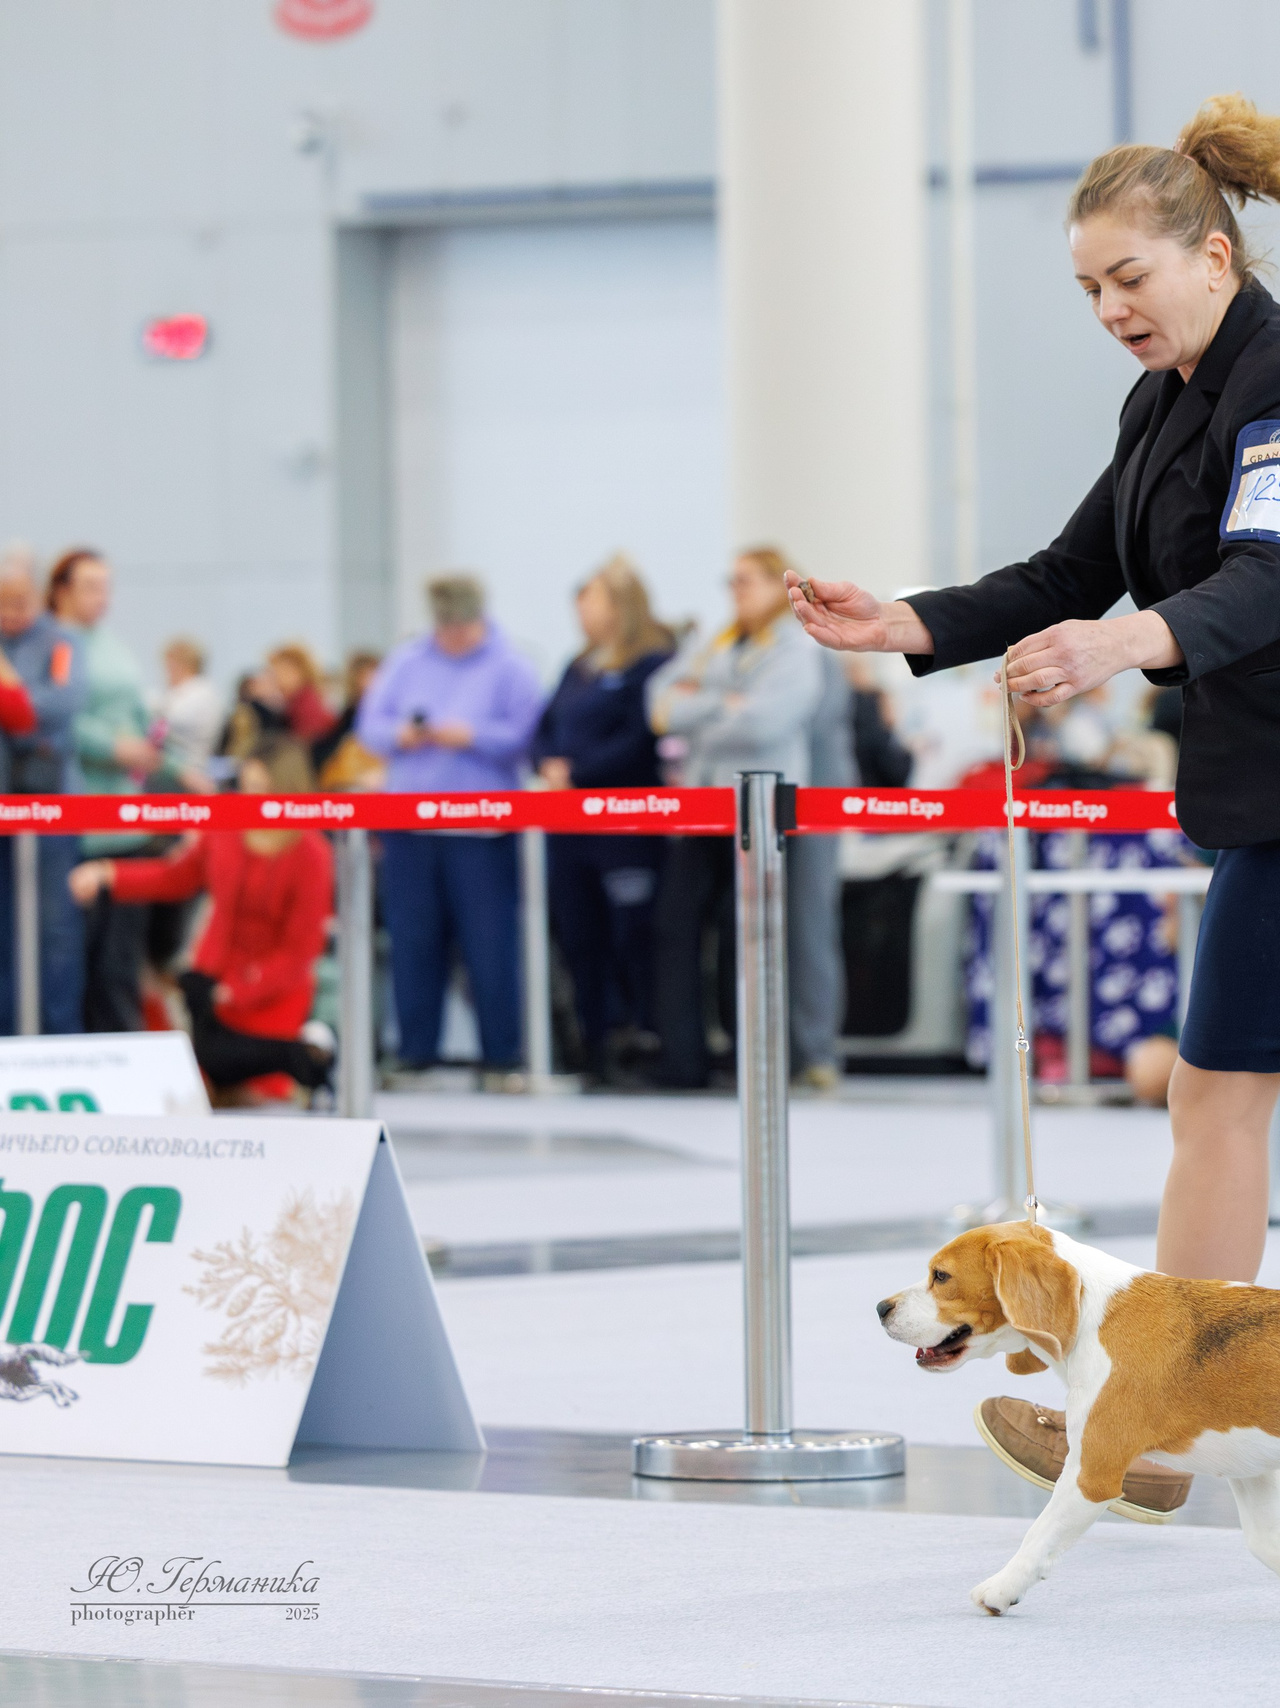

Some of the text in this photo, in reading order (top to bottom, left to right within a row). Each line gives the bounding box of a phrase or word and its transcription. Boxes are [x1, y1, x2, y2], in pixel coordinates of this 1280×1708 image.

[866, 798, 944, 820] Kazan Expo
[1028, 800, 1107, 822] Kazan Expo
[84, 1135, 266, 1159] СОБАКОВОДСТВА
